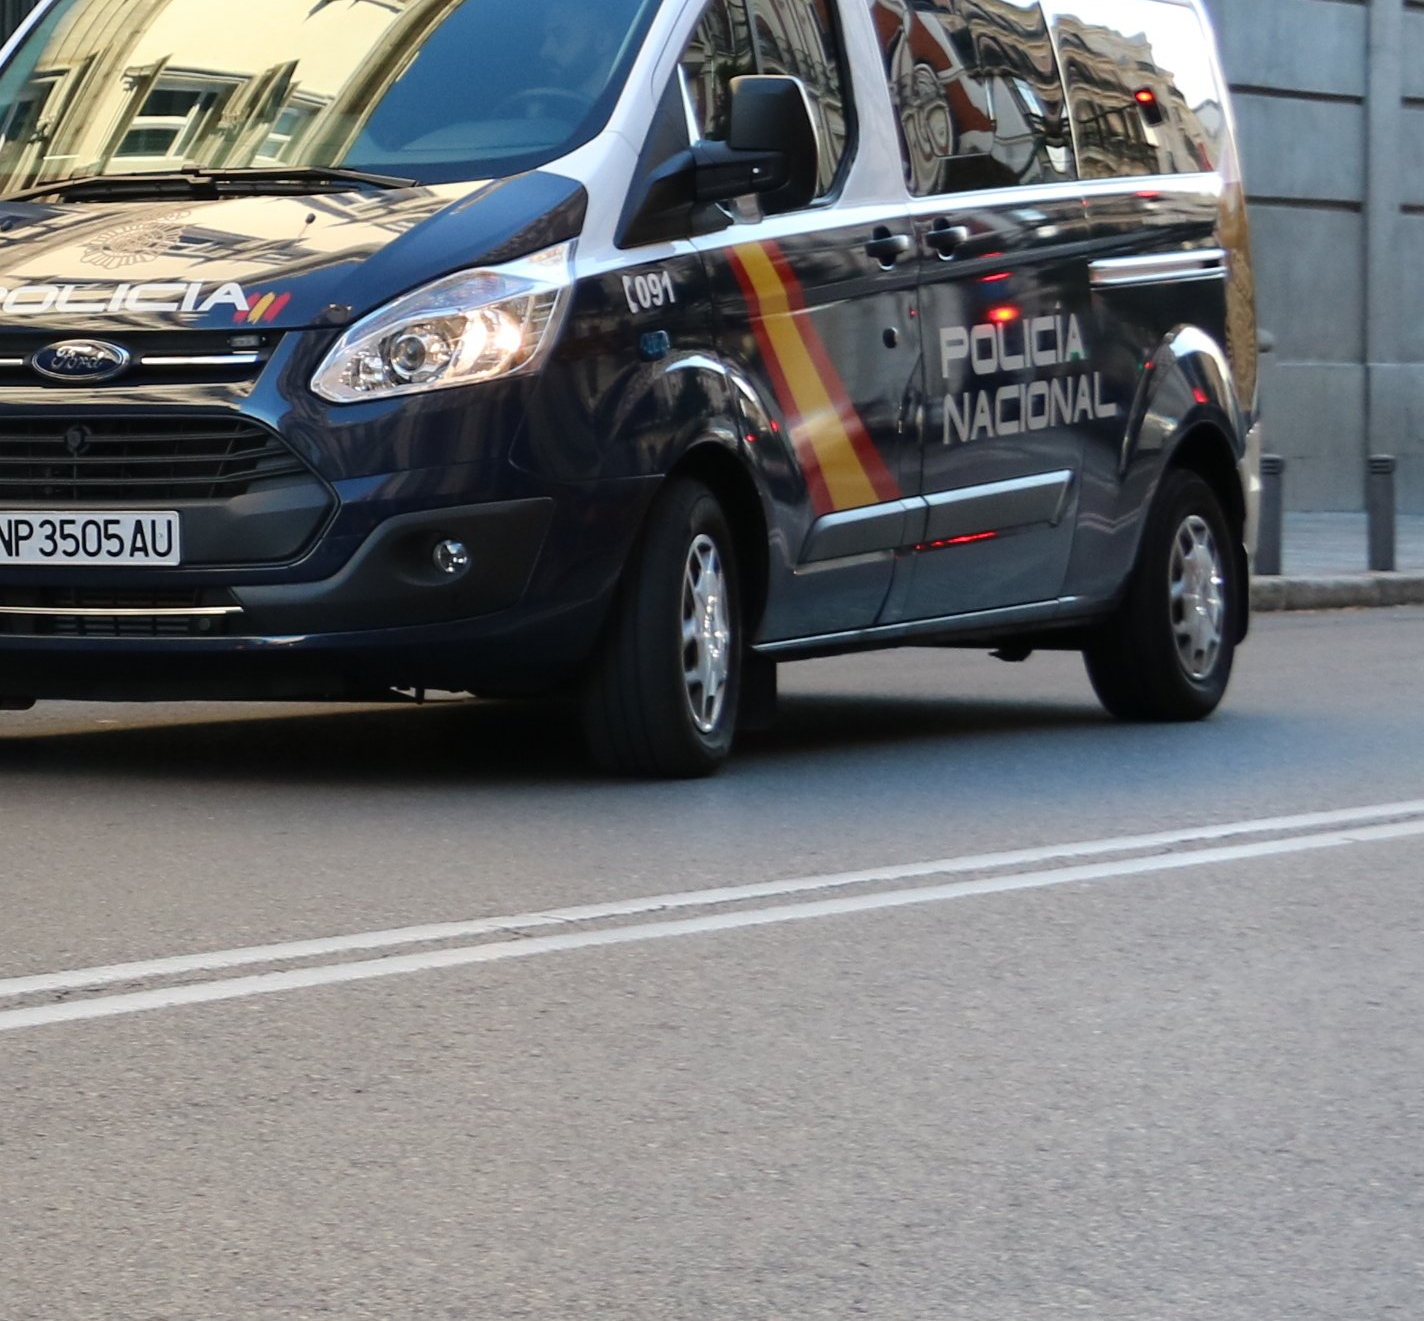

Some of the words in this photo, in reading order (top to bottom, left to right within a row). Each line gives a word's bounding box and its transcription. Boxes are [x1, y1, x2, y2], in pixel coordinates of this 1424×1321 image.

[634, 271, 676, 309] 091
[51, 345, 104, 369] Ford
[942, 371, 1118, 445] NACIONAL
